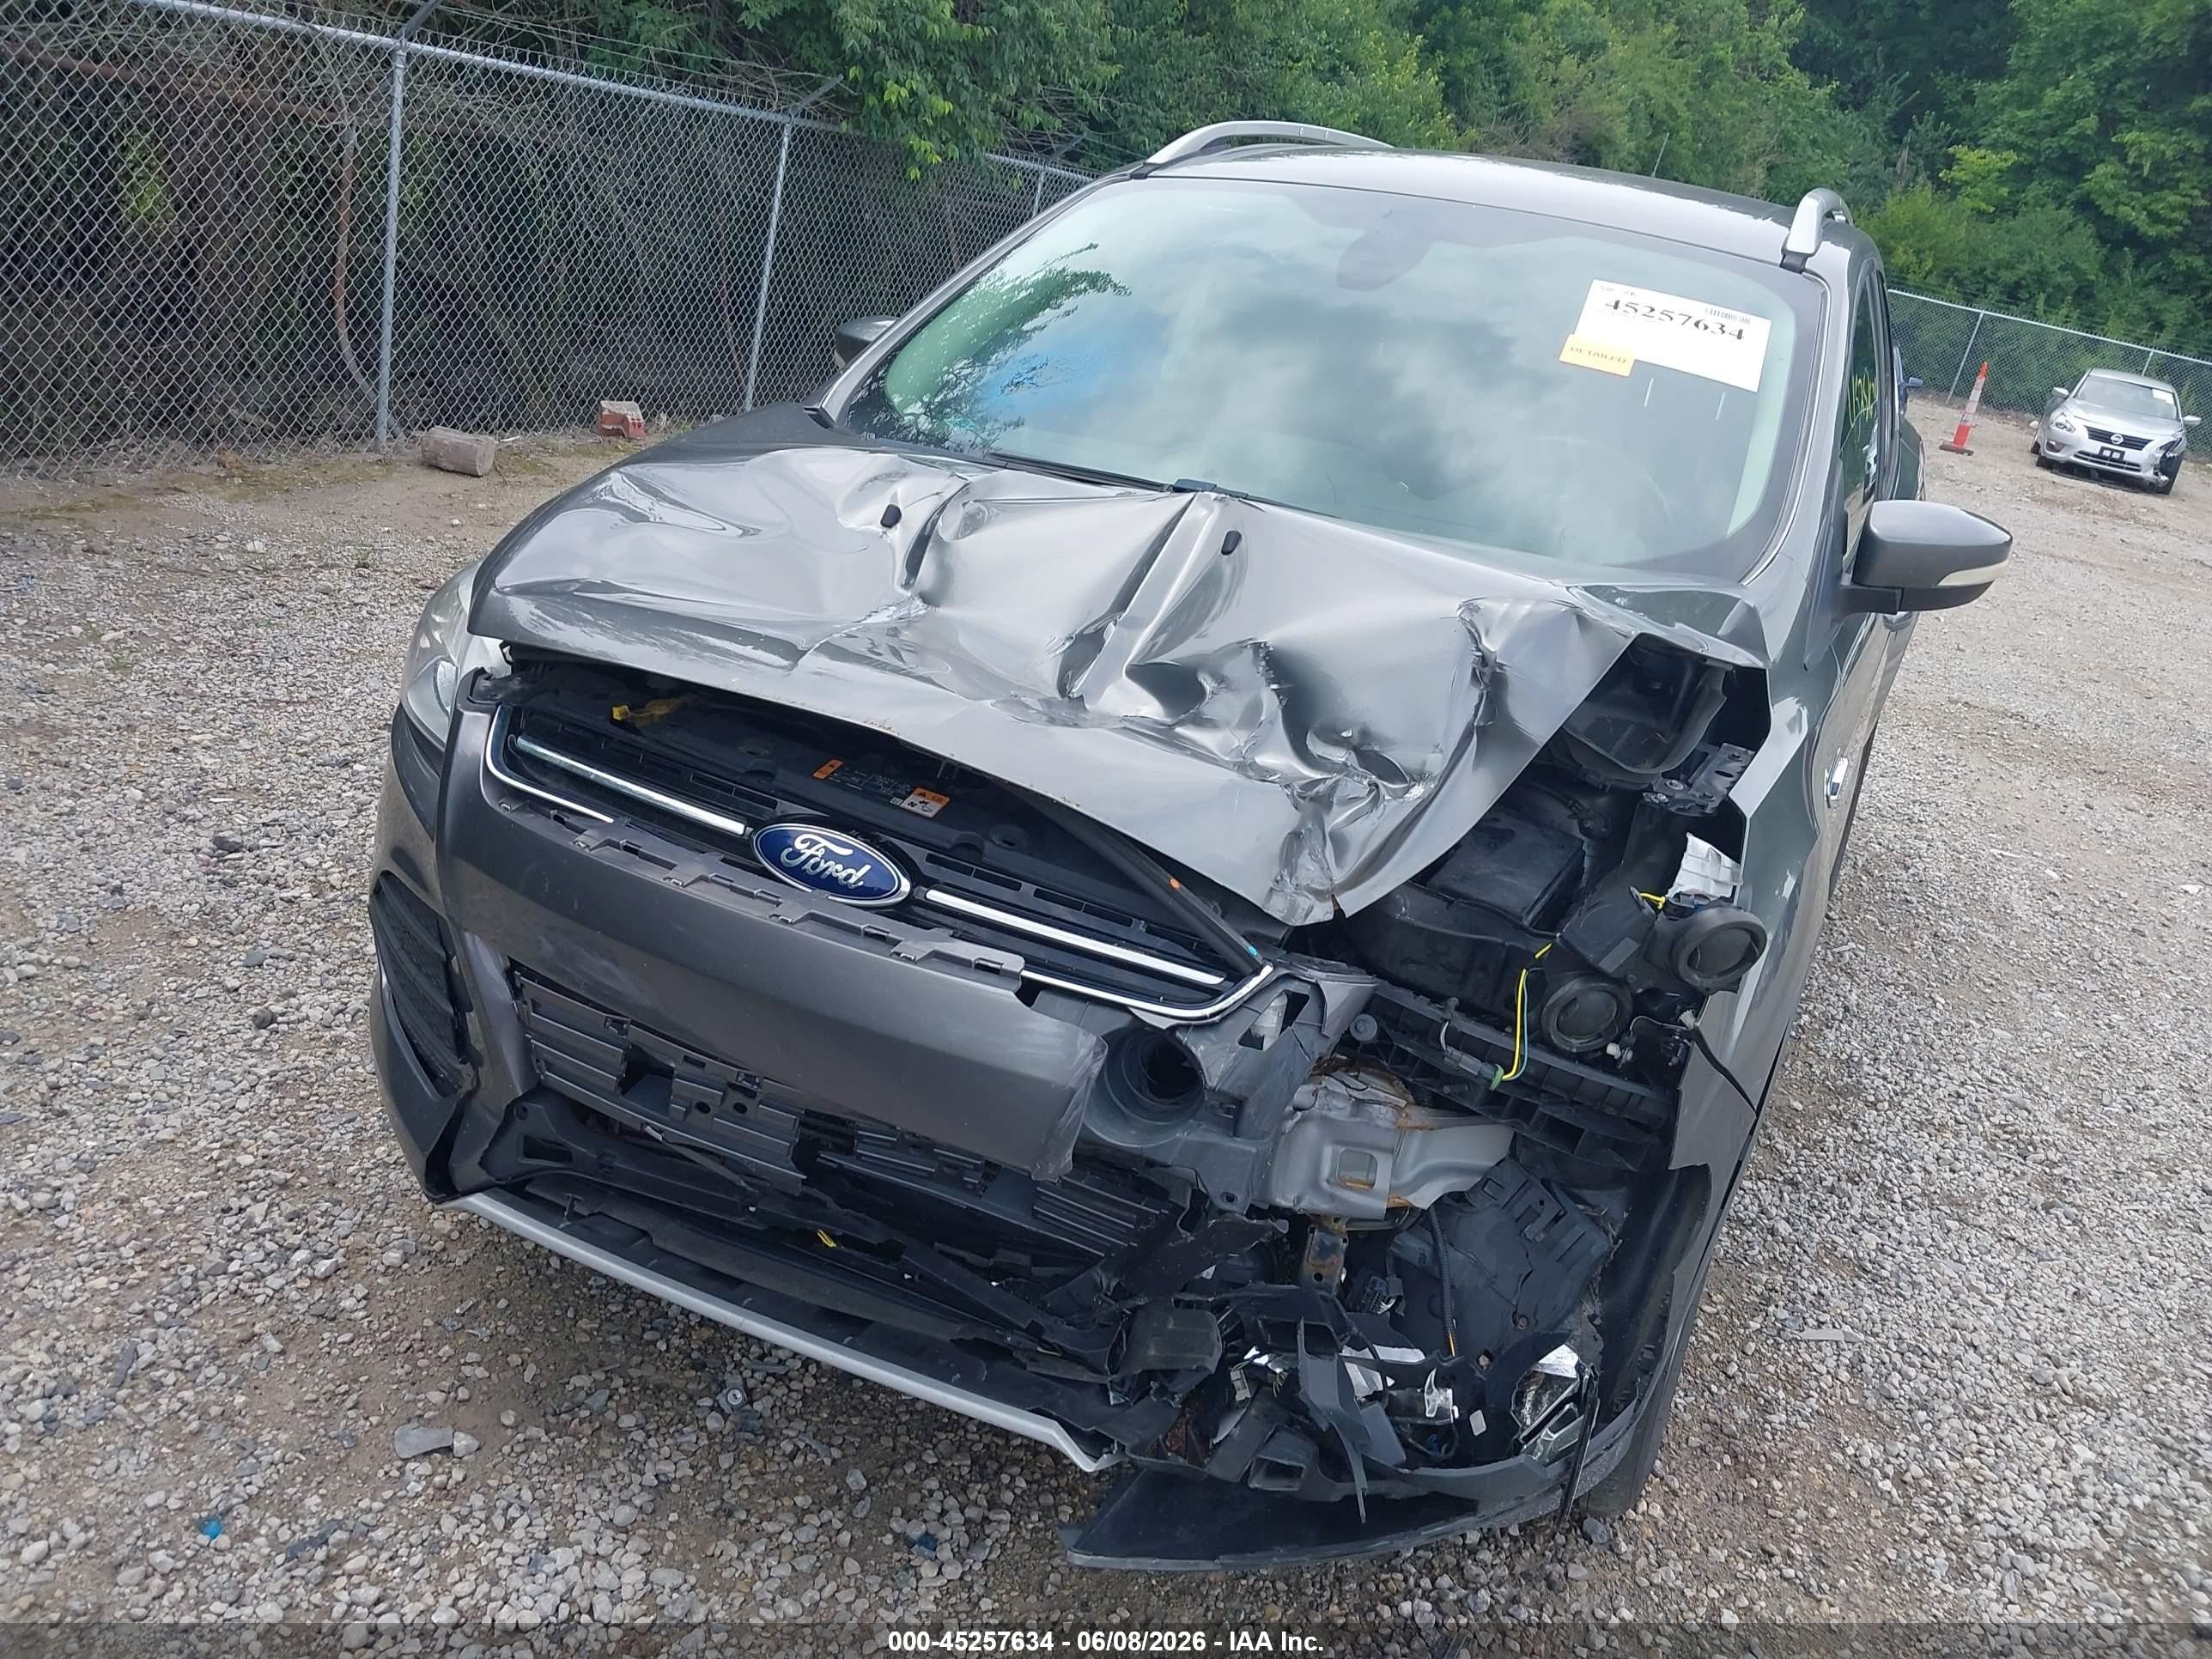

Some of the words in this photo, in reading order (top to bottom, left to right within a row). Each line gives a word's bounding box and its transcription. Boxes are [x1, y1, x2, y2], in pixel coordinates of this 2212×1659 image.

[1605, 298, 1745, 341] 45257634
[1569, 345, 1628, 364] DETAILED
[780, 833, 872, 889] Ford
